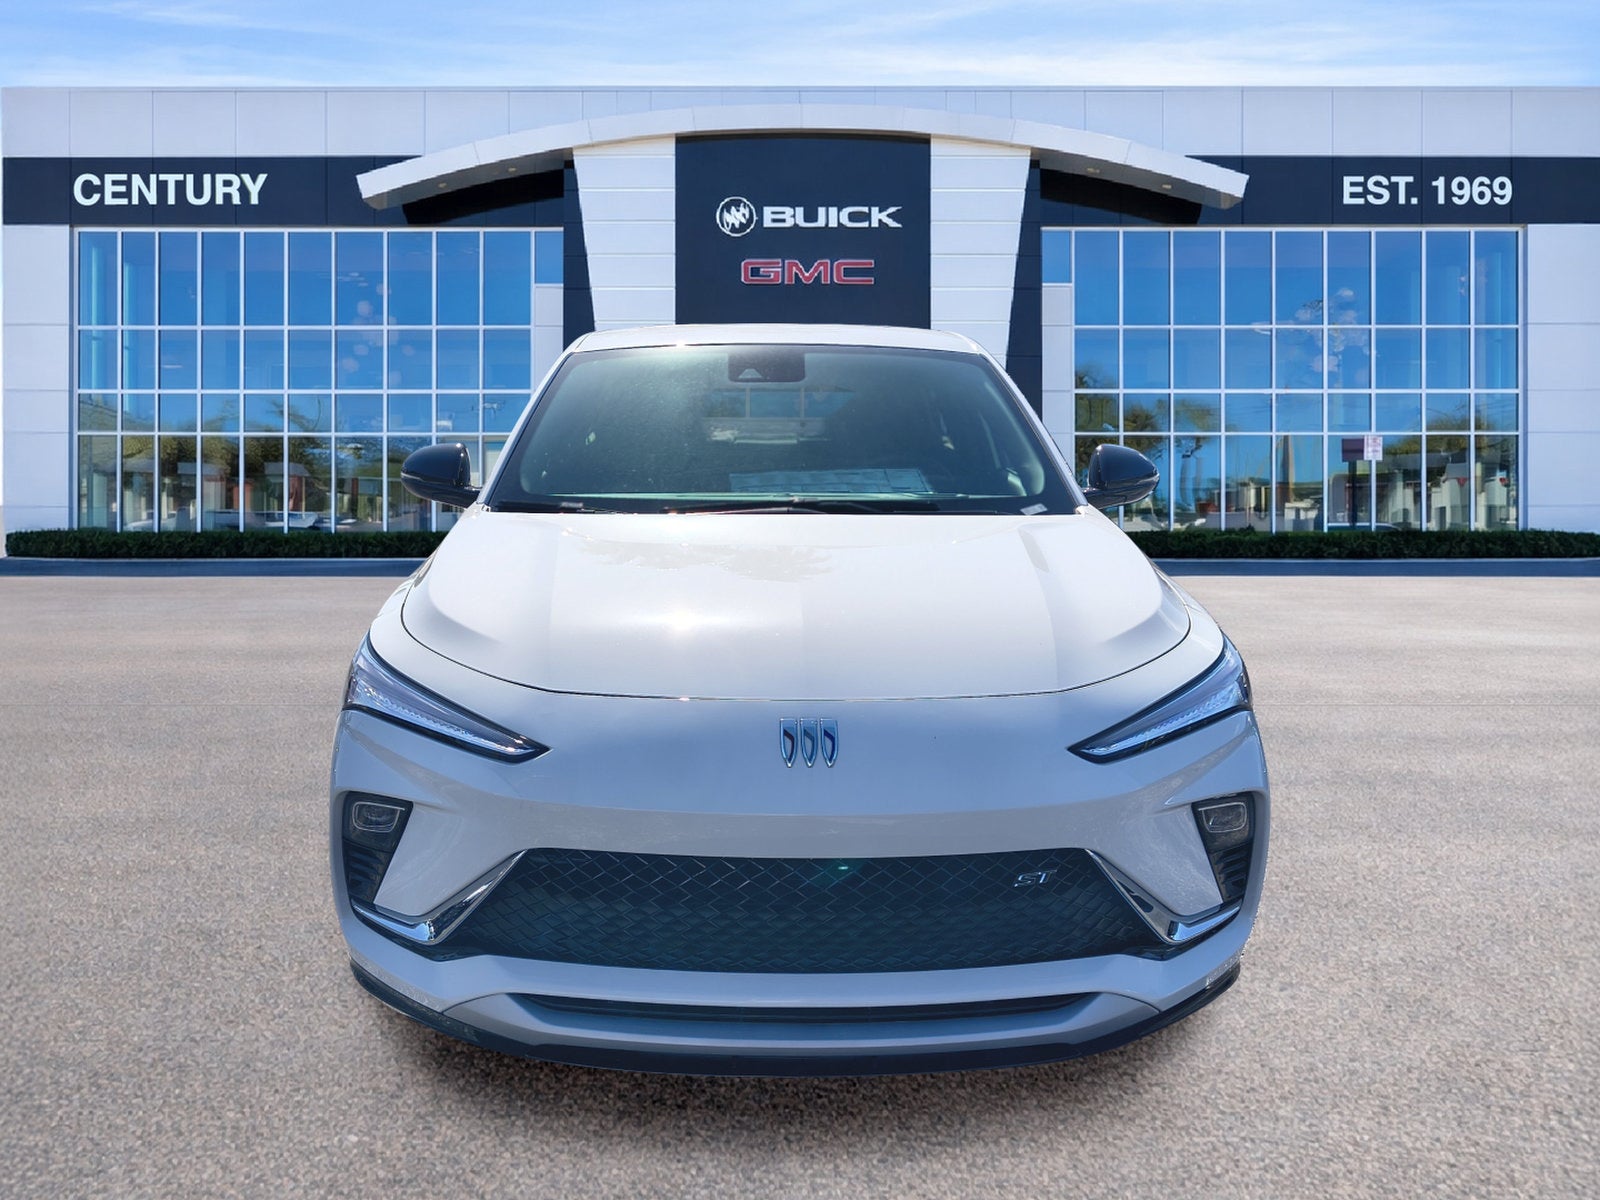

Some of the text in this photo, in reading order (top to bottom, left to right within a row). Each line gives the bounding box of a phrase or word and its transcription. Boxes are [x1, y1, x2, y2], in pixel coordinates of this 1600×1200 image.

[73, 173, 268, 206] CENTURY
[1342, 175, 1513, 205] EST. 1969
[763, 206, 902, 228] BUICK
[741, 258, 875, 285] GMC
[1013, 869, 1057, 888] ST
